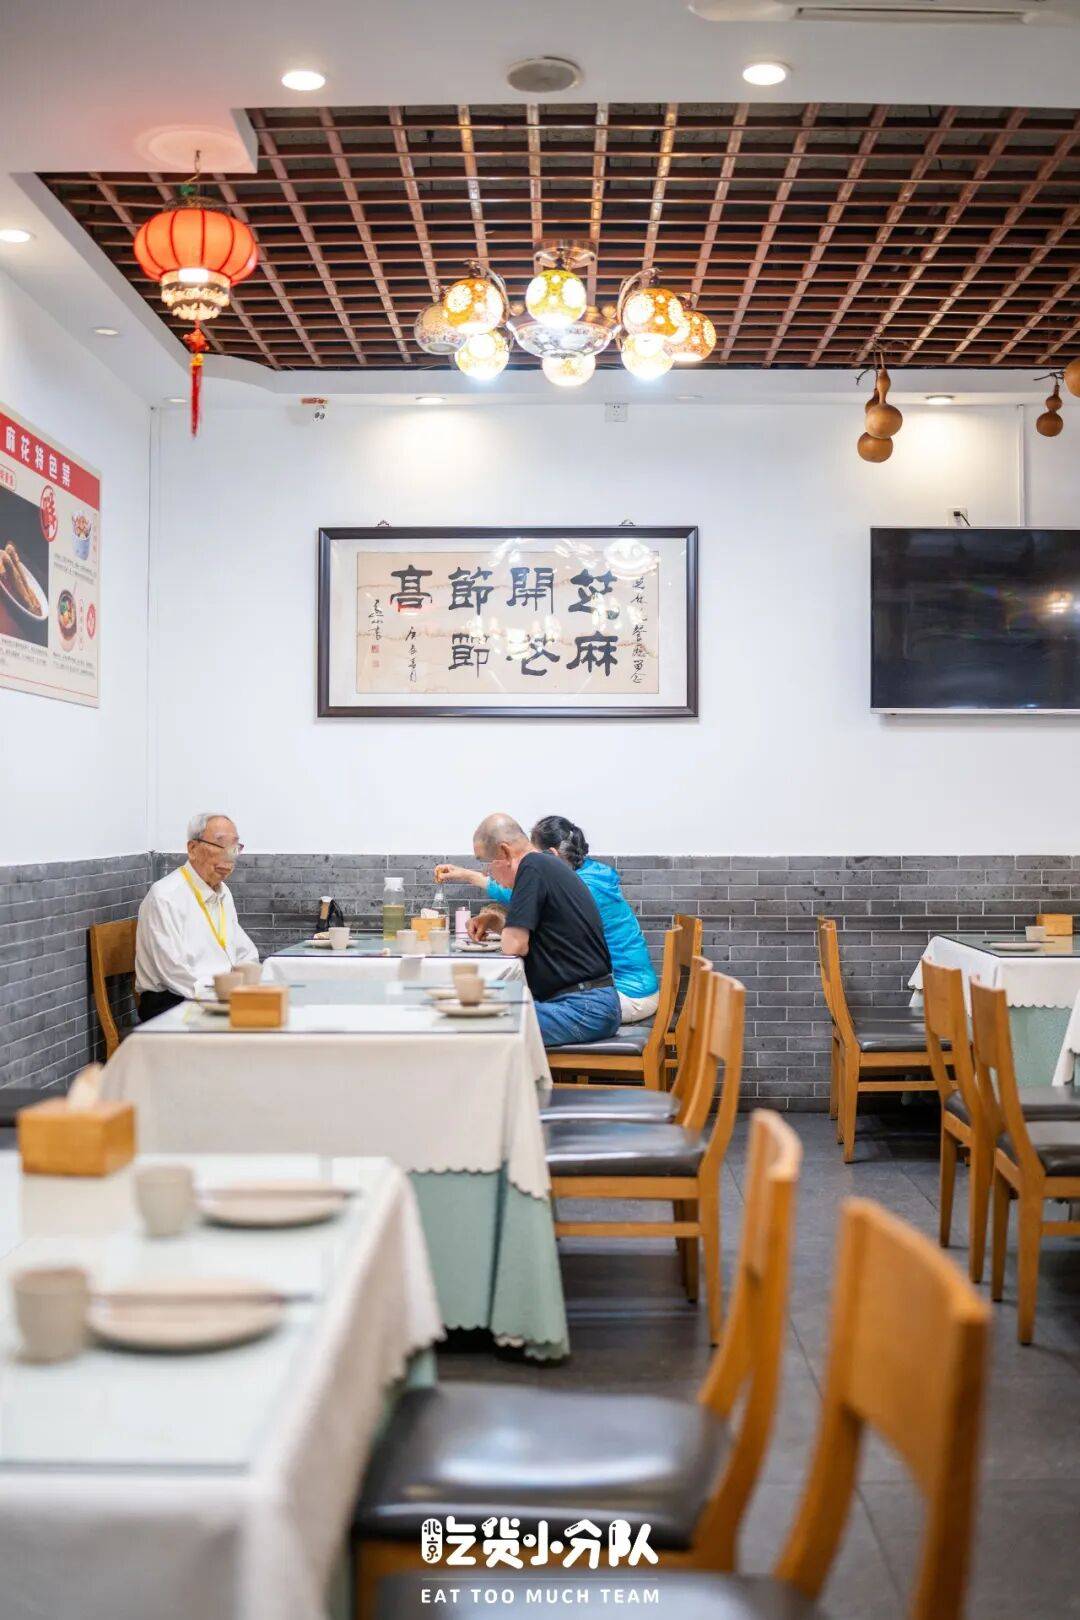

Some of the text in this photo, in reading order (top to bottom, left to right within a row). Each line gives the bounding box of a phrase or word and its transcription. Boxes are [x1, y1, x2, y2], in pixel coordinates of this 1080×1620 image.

[6, 426, 71, 487] 麻花特色菜
